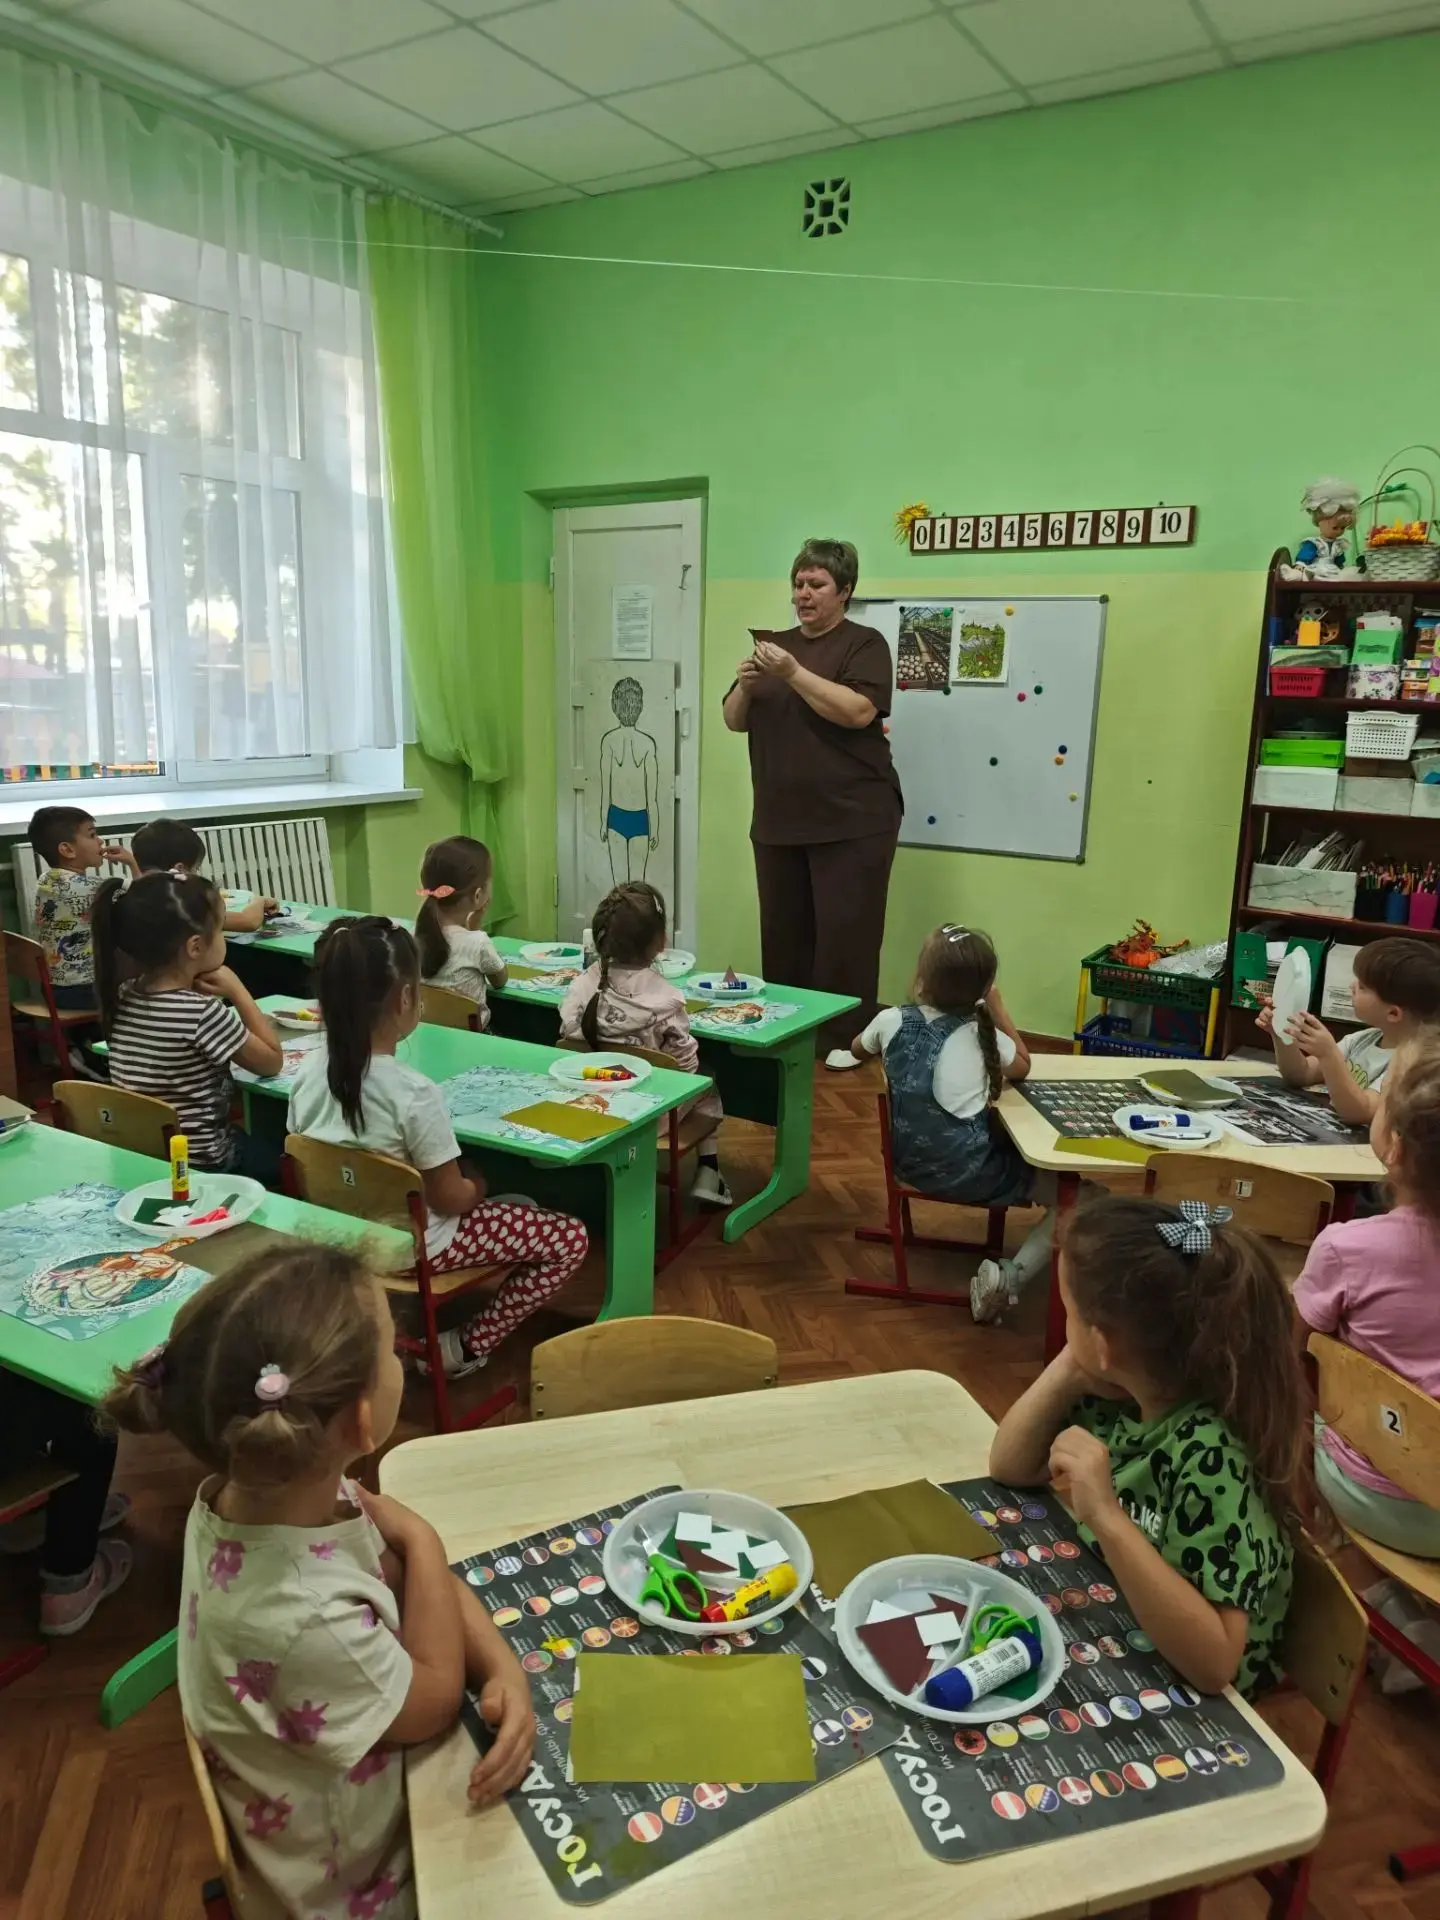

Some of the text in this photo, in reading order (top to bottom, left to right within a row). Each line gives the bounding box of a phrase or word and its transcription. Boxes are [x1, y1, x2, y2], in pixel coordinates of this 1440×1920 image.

[916, 511, 1182, 545] 0 1 2 3 4 5 6 7 8 9 10
[102, 1110, 111, 1123] 2
[344, 1171, 353, 1184] 2
[1387, 1410, 1400, 1433] 2
[1130, 1502, 1161, 1539] LIKE
[894, 1724, 966, 1845] ГОСУД
[520, 1759, 603, 1888] ГОСУД
